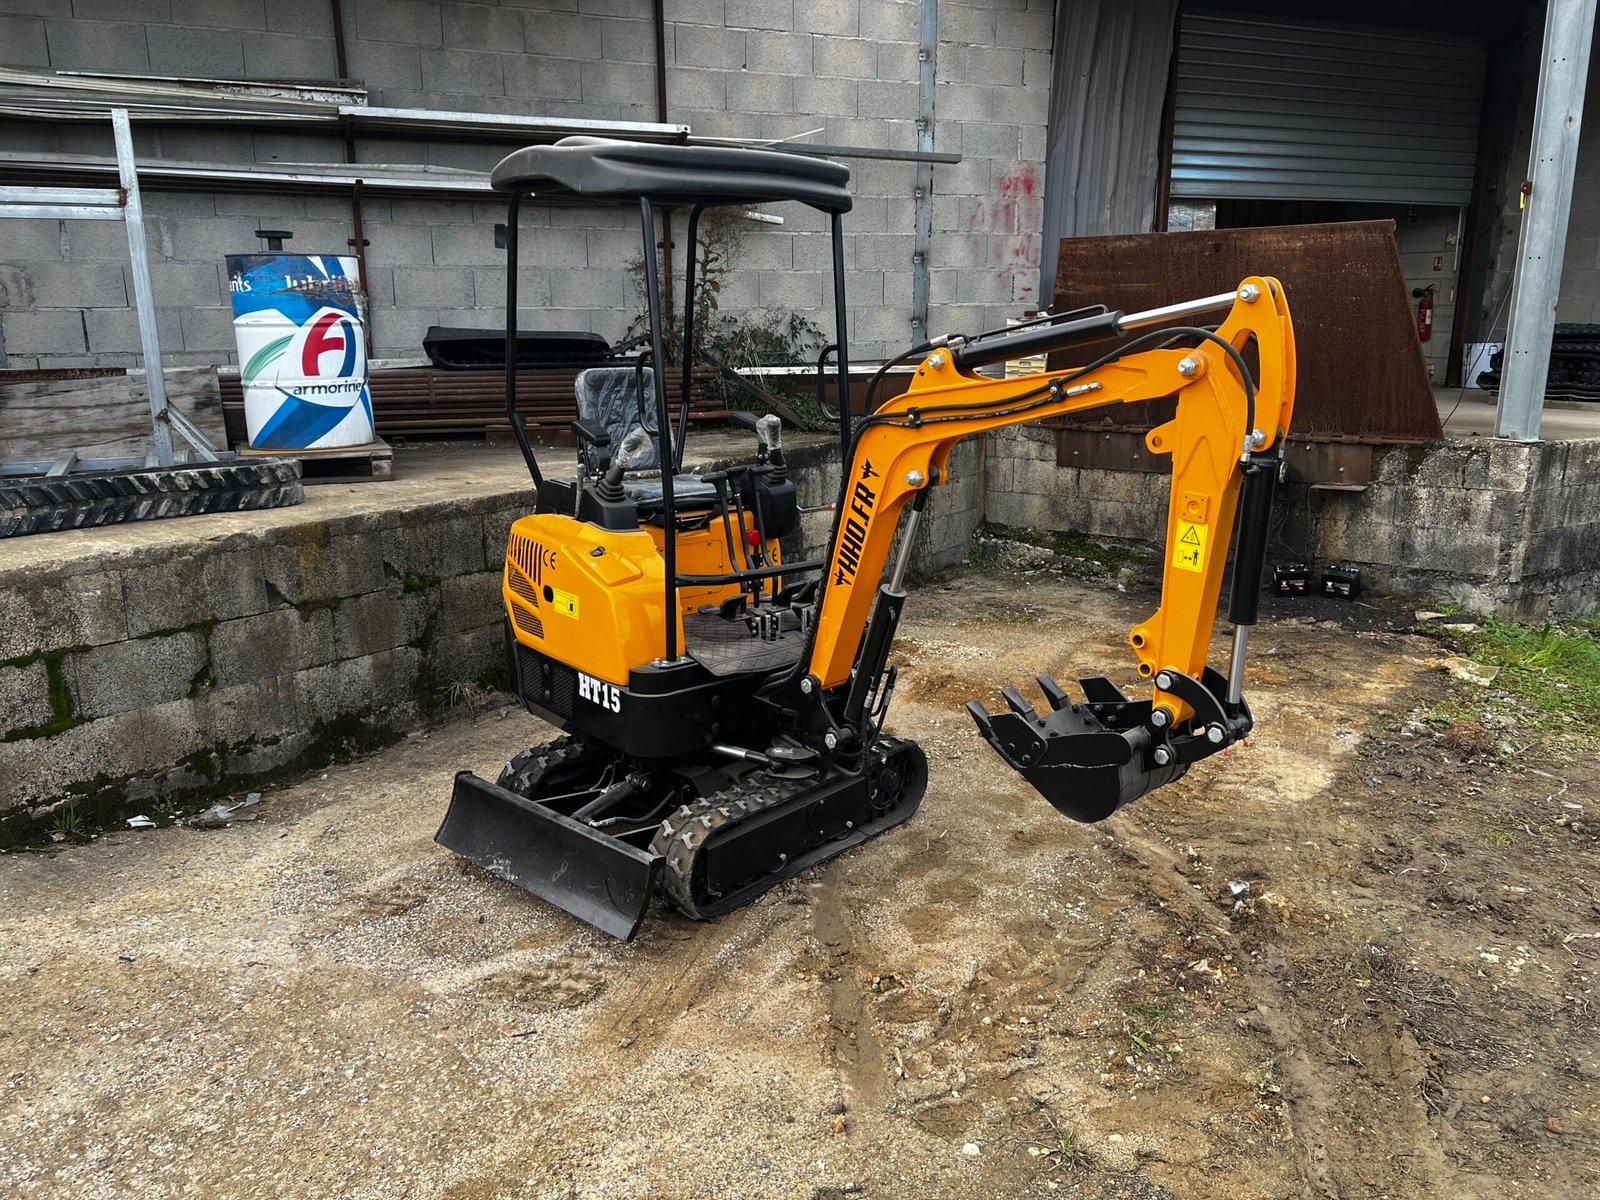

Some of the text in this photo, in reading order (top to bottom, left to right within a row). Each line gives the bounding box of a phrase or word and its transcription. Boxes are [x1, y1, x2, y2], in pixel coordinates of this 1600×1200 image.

[293, 380, 361, 395] armorine
[838, 481, 876, 577] HHO.FR
[542, 549, 557, 570] CE
[578, 672, 621, 713] HT15
